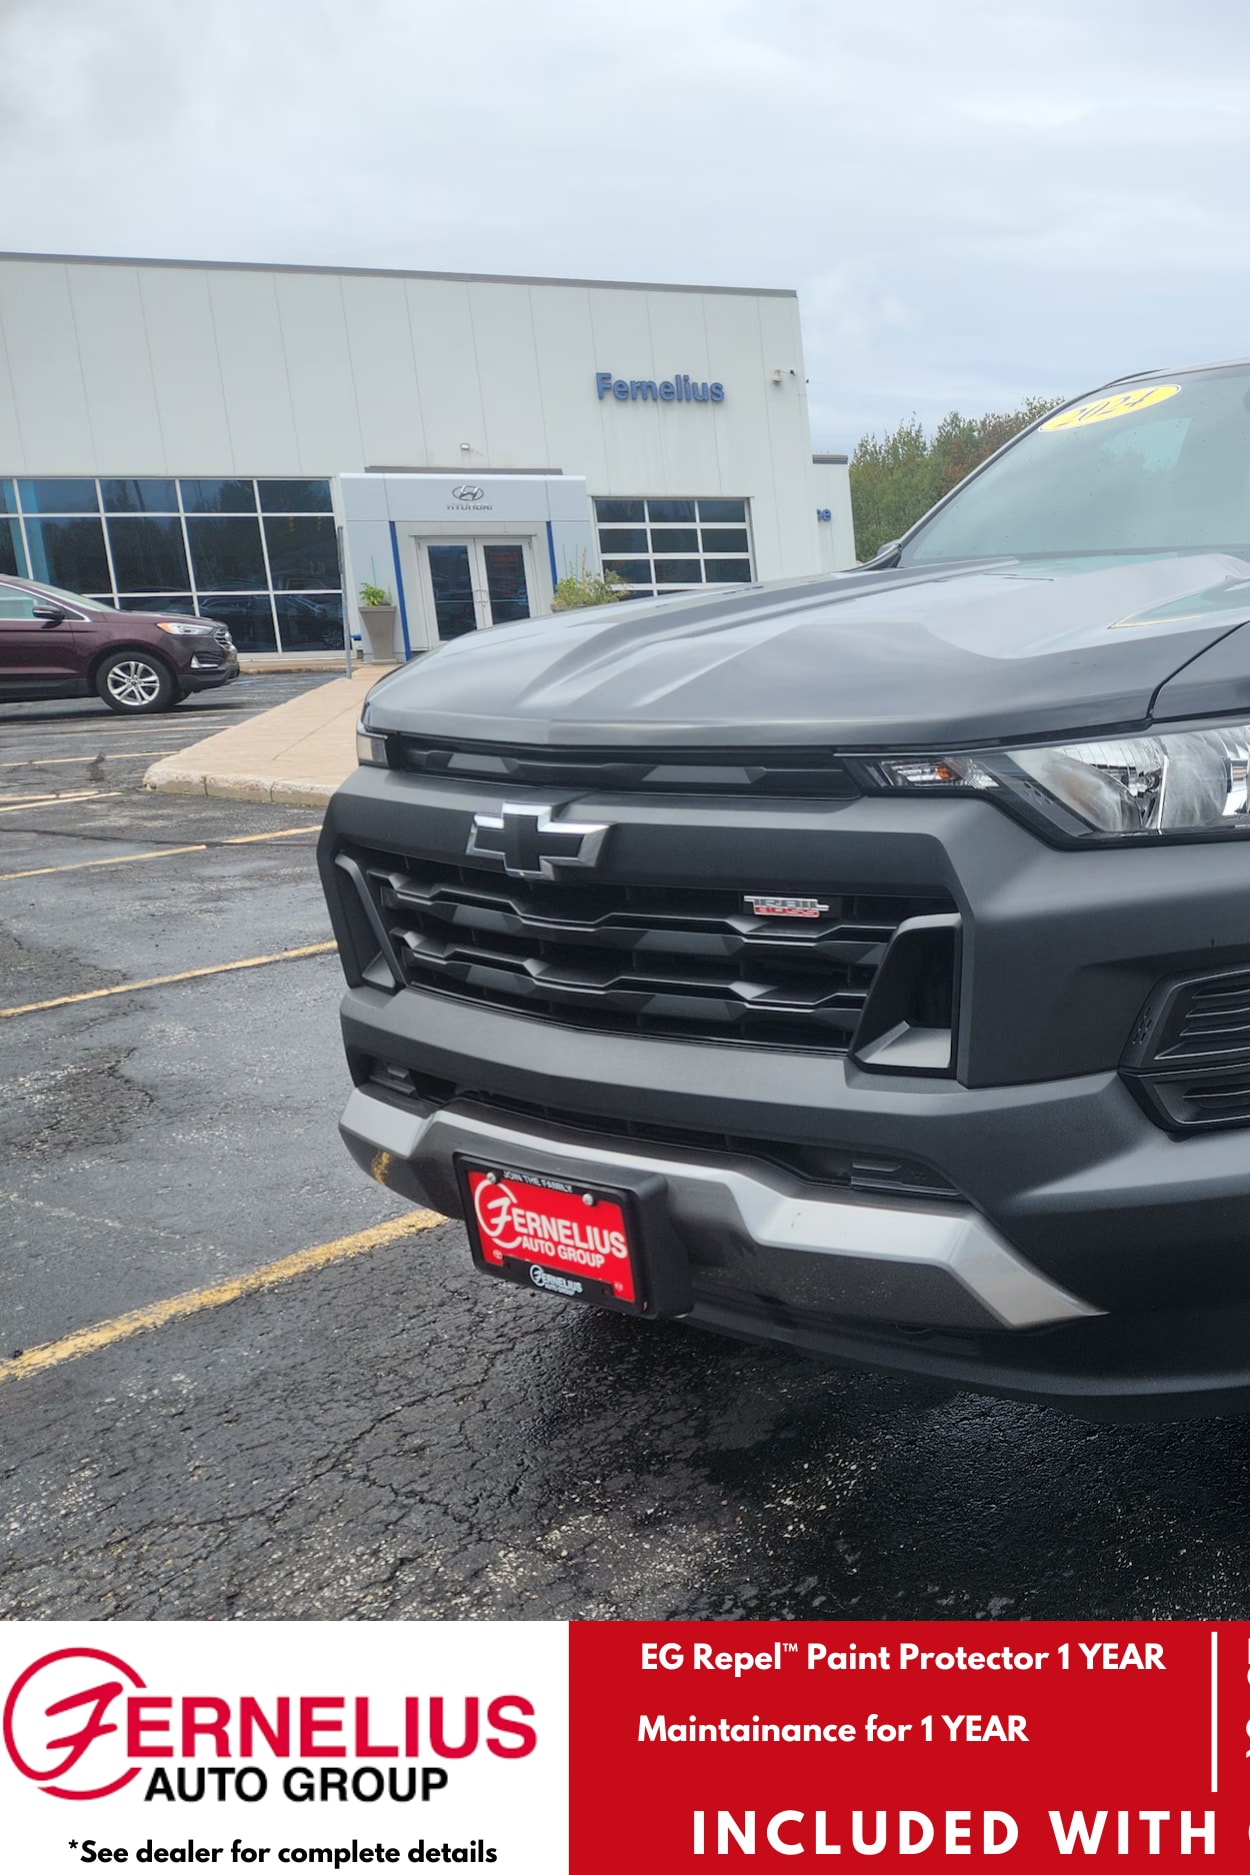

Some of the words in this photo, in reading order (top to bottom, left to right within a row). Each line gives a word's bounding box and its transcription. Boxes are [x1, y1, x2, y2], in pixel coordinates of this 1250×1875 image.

[596, 372, 725, 401] Fernelius
[1055, 387, 1158, 428] 2024
[447, 503, 493, 511] HYUNDAI
[523, 1174, 541, 1187] THE
[484, 1196, 629, 1259] FERNELIUS
[522, 1235, 556, 1257] AUTO
[557, 1245, 605, 1269] GROUP
